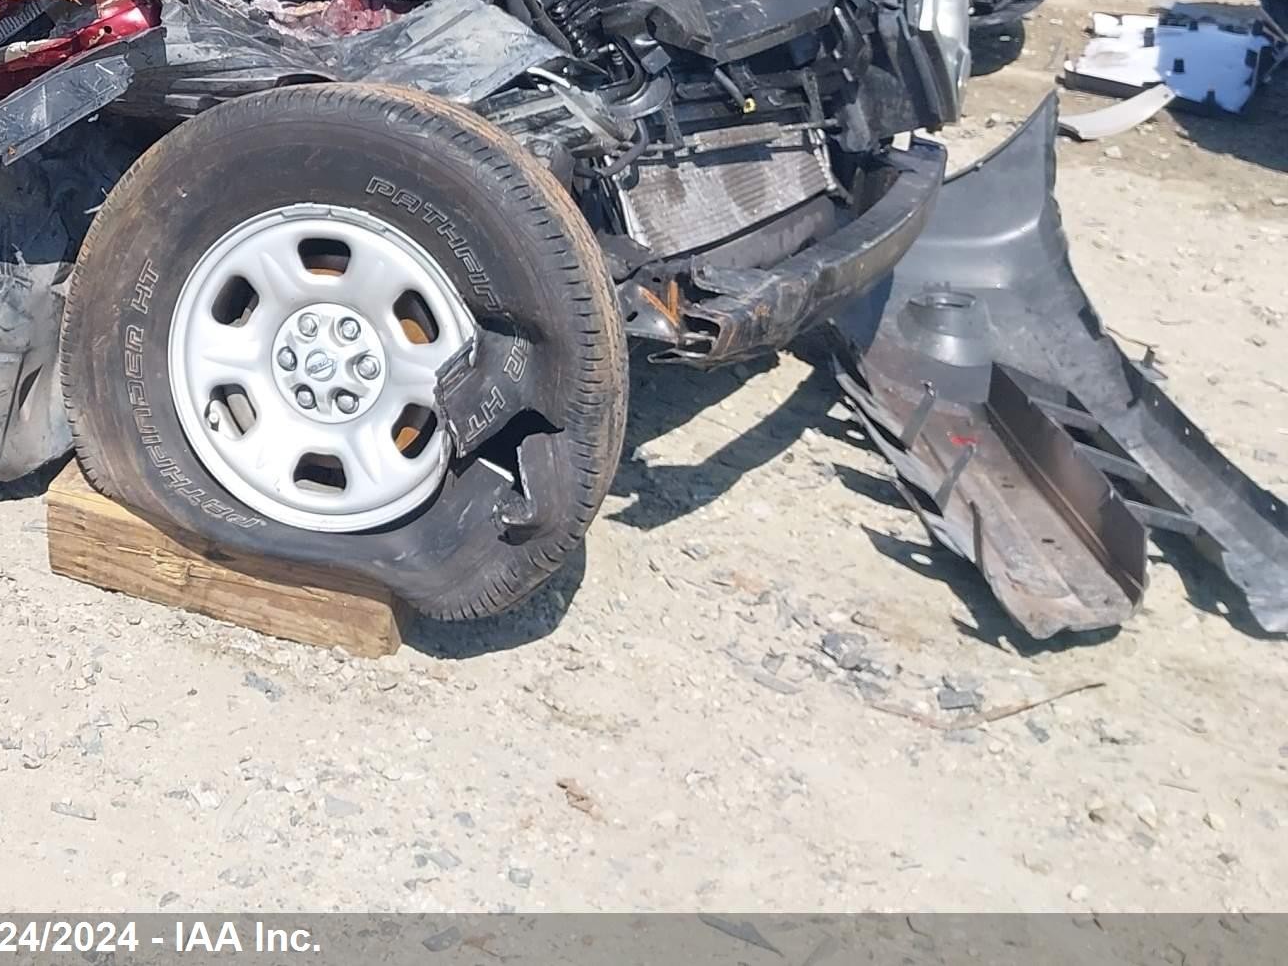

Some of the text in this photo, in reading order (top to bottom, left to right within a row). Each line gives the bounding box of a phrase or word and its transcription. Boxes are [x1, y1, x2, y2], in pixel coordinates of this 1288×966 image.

[124, 258, 268, 529] PATHFINDER HT
[464, 385, 506, 443] HT
